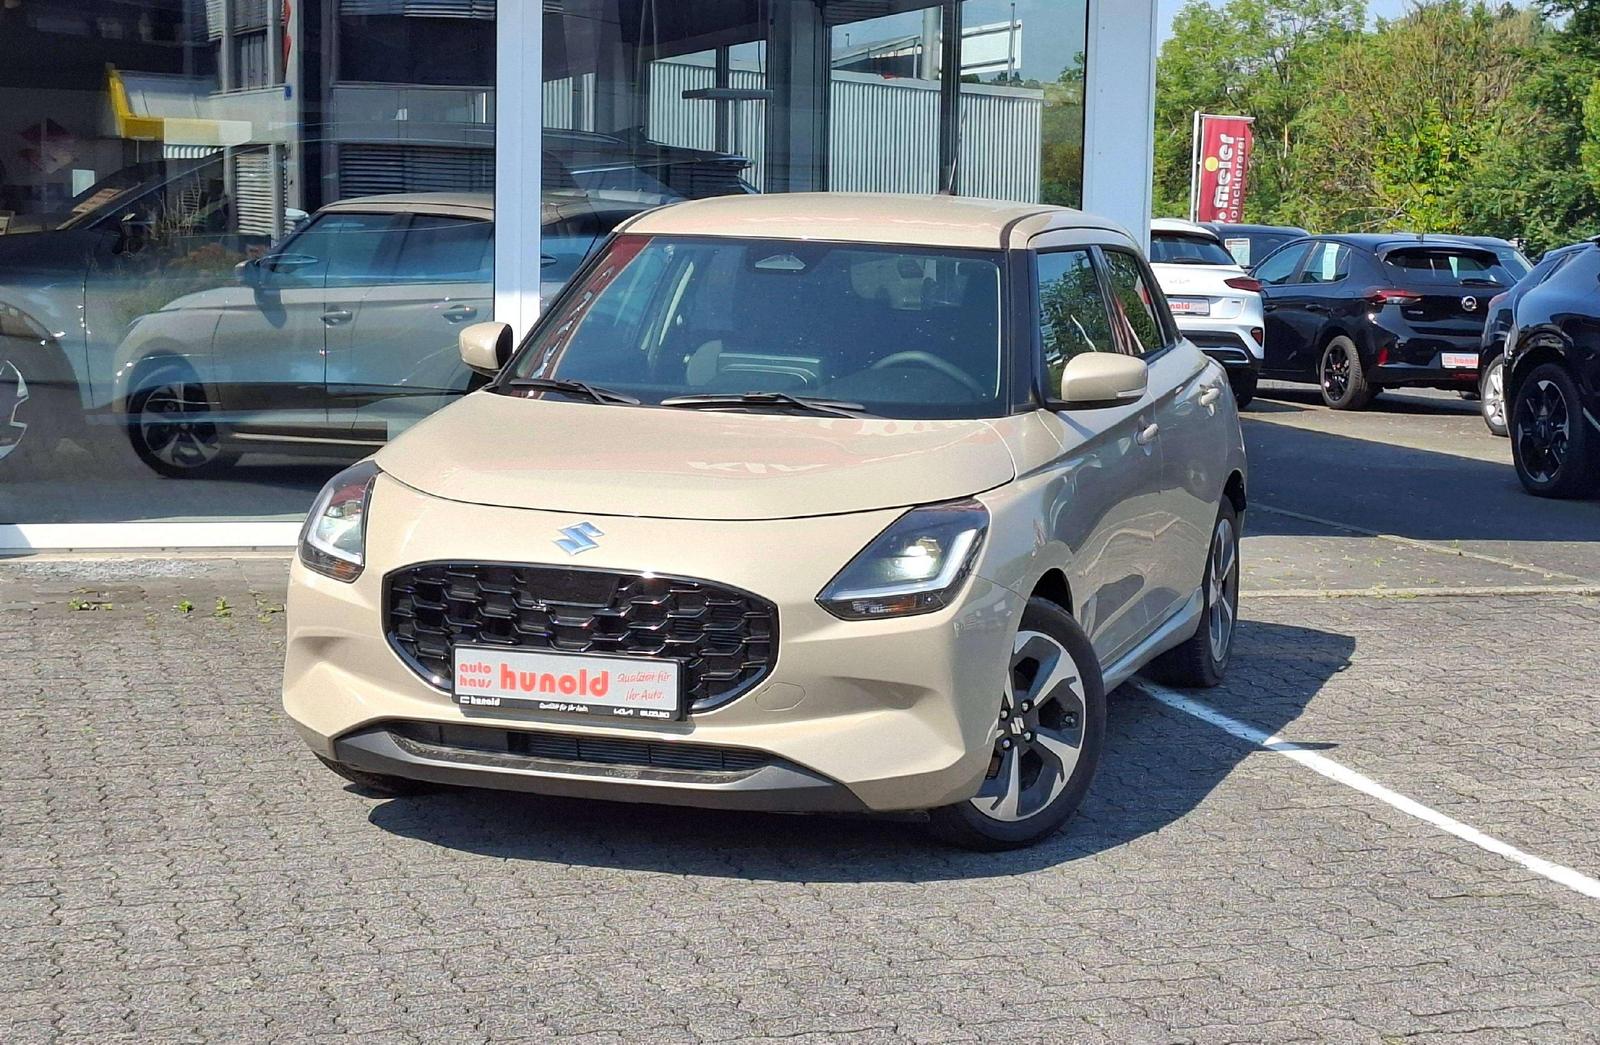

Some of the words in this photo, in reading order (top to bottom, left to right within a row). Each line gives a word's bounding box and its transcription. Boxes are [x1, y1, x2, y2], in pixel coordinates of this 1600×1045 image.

[1206, 133, 1234, 208] meier
[1228, 137, 1245, 222] tolackiererei
[459, 662, 492, 674] auto
[459, 675, 492, 689] haus
[500, 663, 609, 698] hunold
